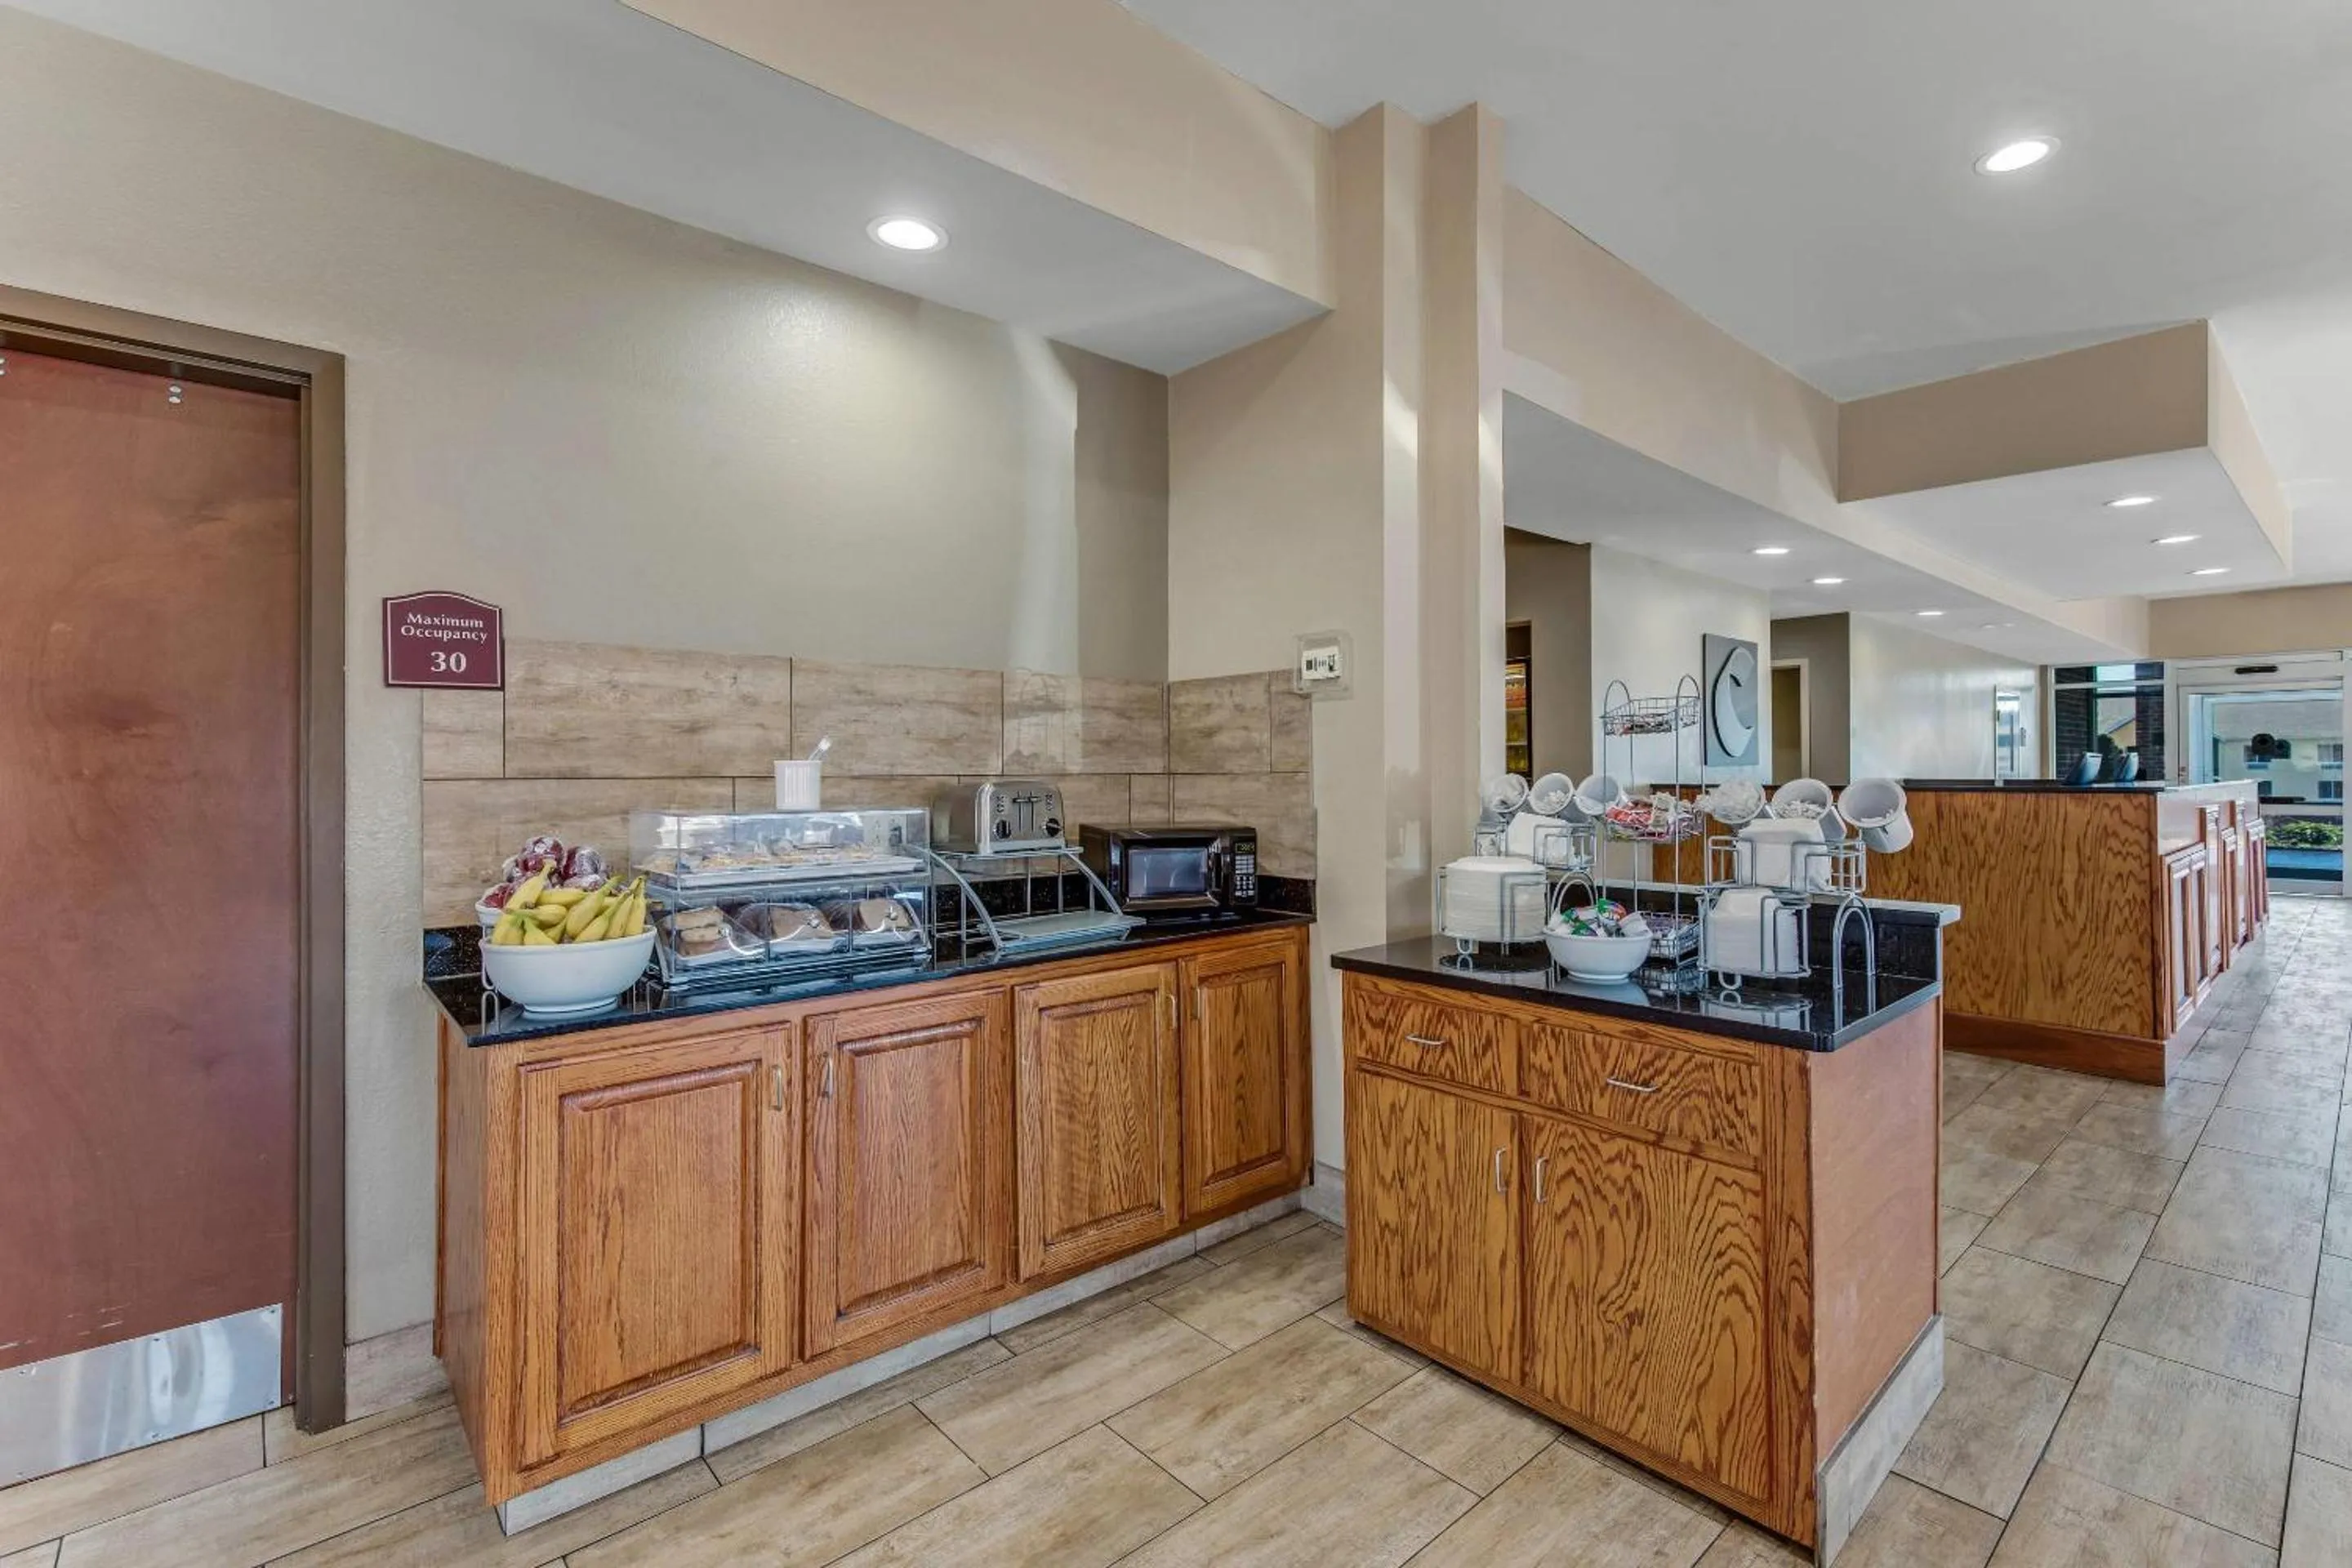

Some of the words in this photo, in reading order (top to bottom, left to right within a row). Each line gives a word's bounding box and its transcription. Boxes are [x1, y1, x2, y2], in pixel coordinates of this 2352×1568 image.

[408, 612, 483, 628] Maximum
[401, 625, 488, 644] Occupancy
[430, 652, 466, 673] 30
